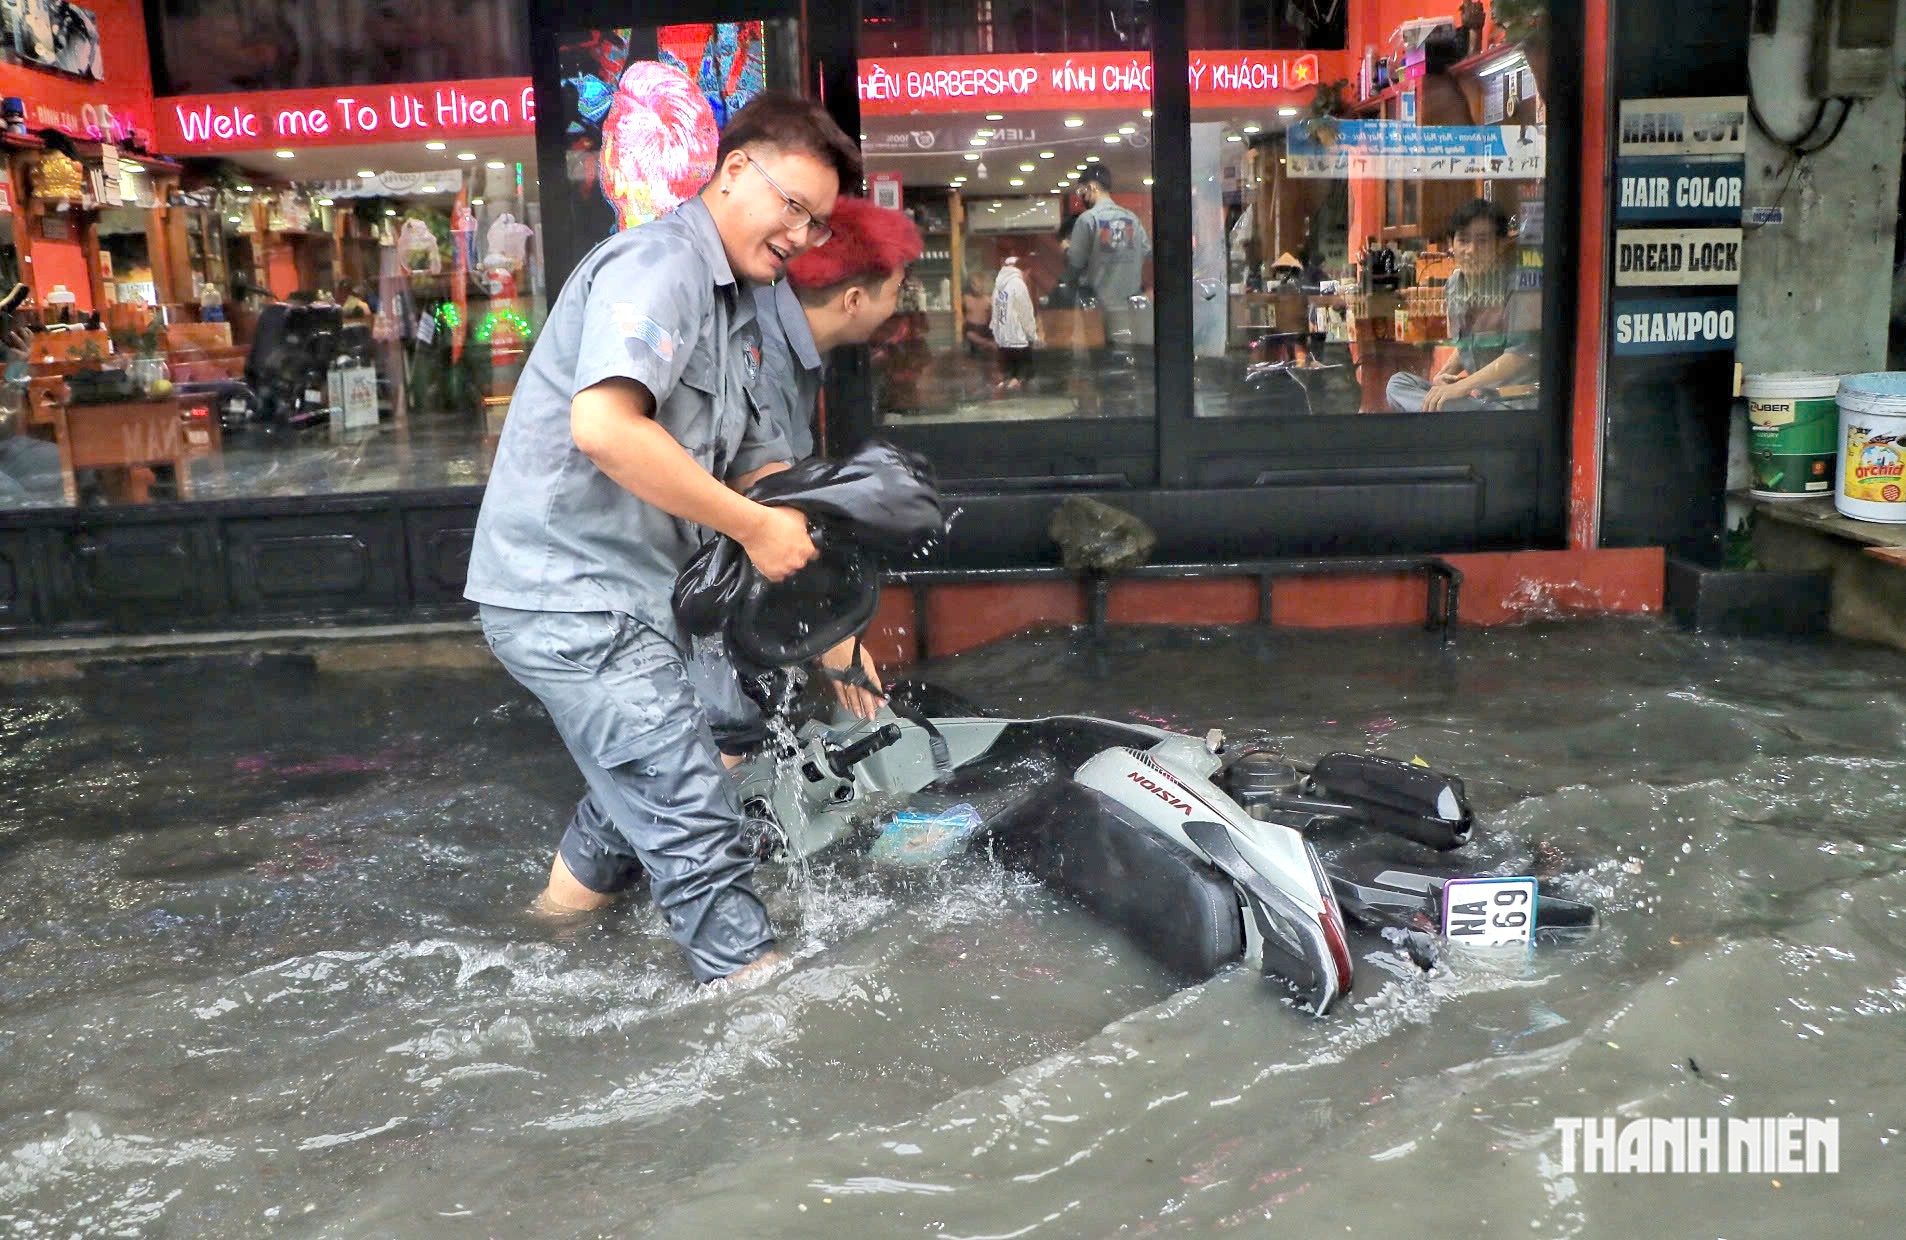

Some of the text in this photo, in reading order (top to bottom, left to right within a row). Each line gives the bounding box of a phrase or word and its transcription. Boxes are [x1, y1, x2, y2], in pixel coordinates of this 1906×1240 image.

[907, 67, 1037, 98] BARBERSHOP
[1052, 60, 1096, 91] KÍNH
[1213, 58, 1278, 90] KHÁCH
[337, 98, 378, 131] To
[390, 94, 427, 129] Ut
[436, 89, 509, 126] Hien
[1621, 176, 1743, 208] HAIR COLOR
[1619, 242, 1738, 274] DREAD LOCK
[1616, 309, 1735, 344] SHAMPOO
[1127, 771, 1192, 816] VISION
